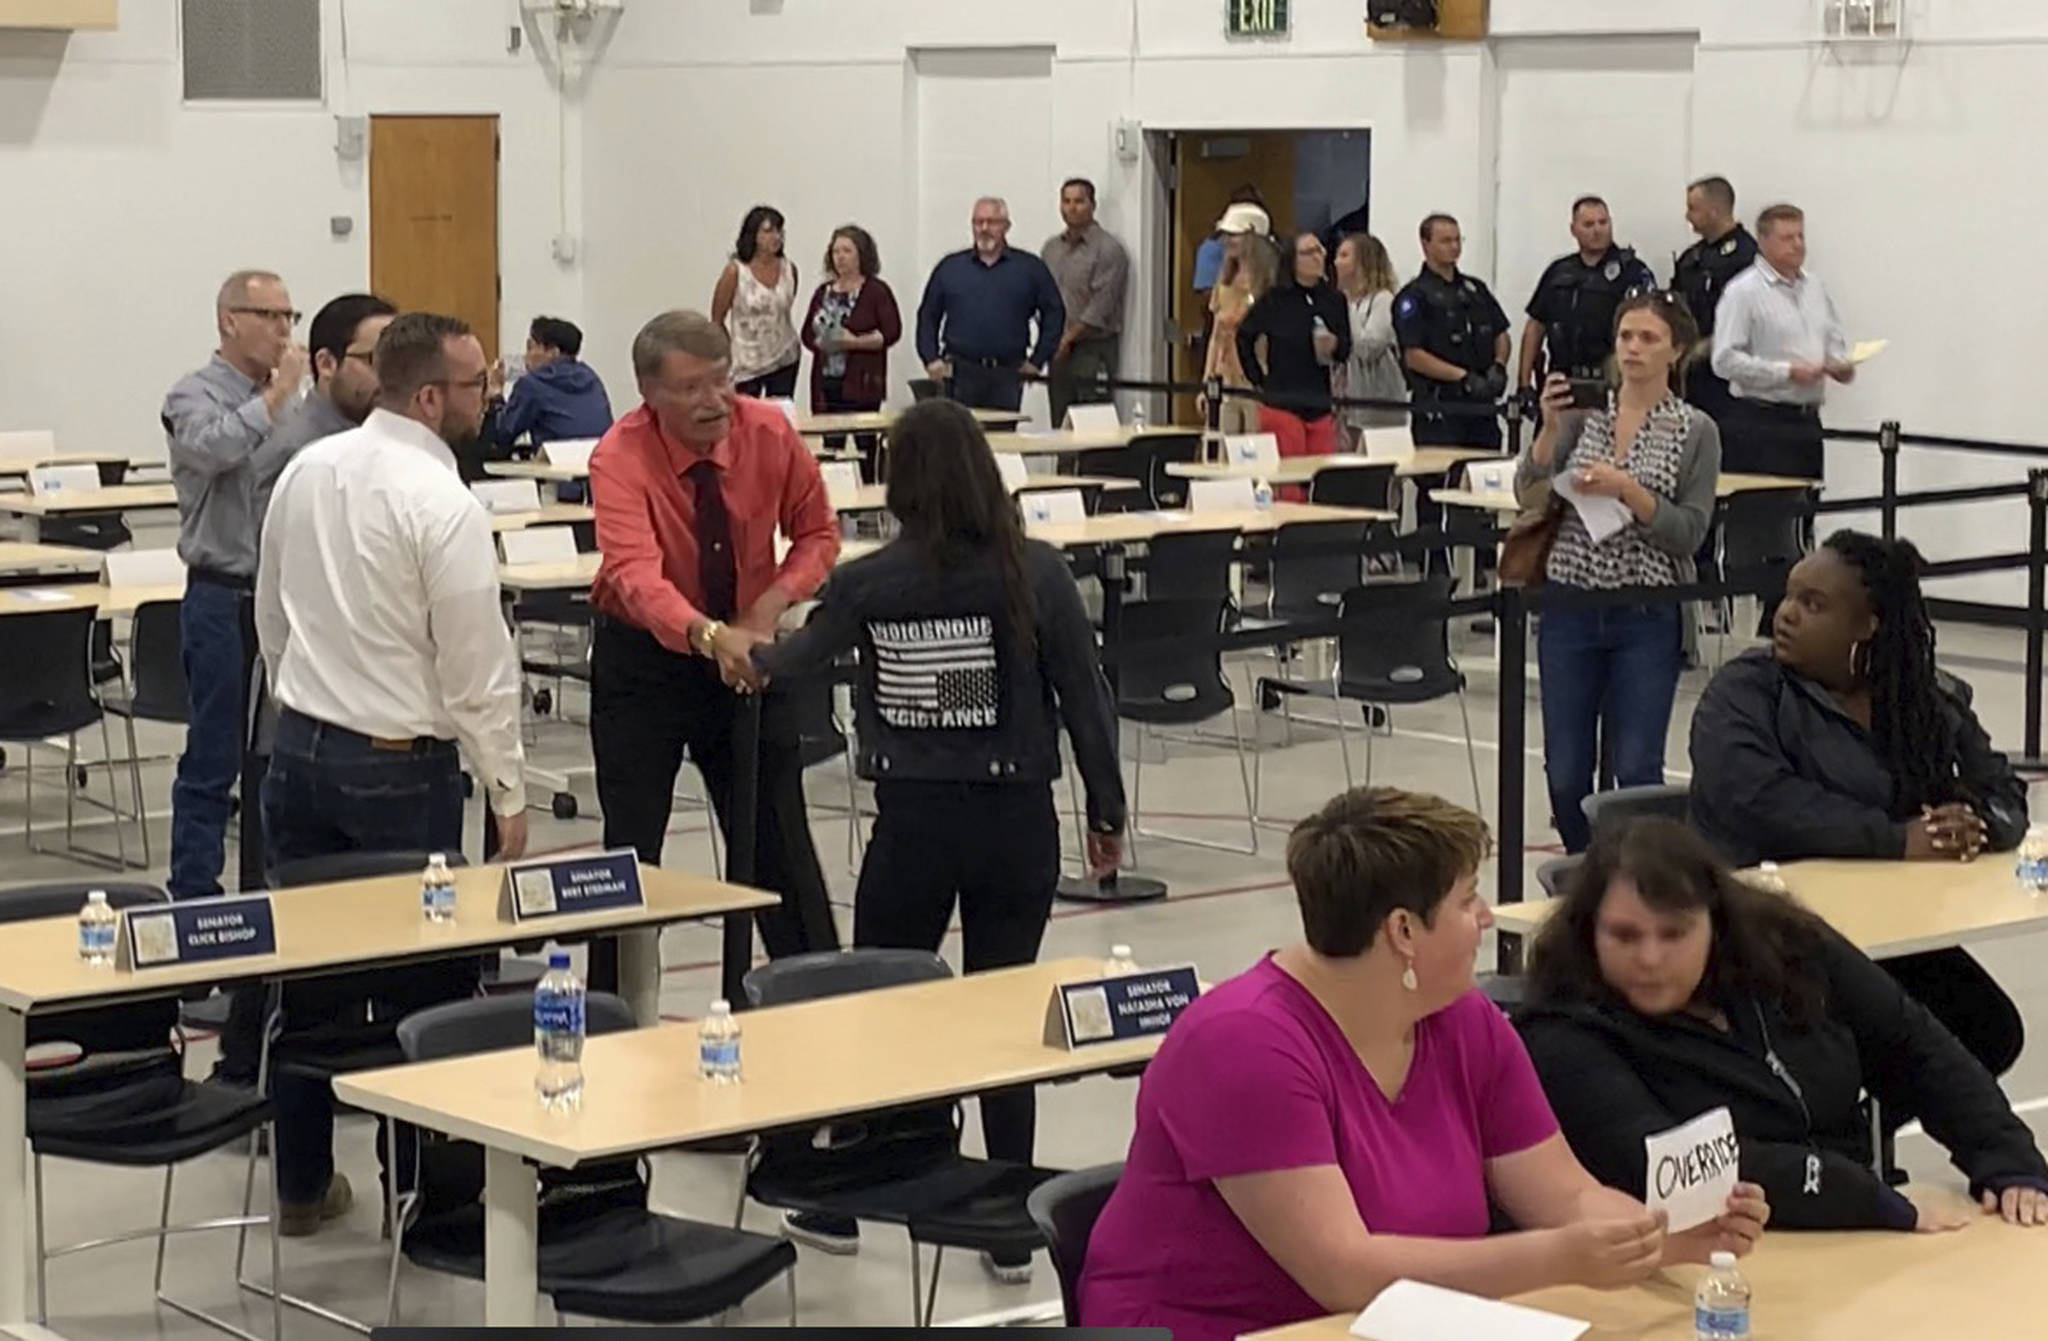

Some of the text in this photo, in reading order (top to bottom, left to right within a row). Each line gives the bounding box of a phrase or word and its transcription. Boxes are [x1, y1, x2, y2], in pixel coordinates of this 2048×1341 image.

[1240, 0, 1275, 31] EXIT
[569, 868, 613, 883] SENATOR
[197, 914, 244, 930] SENATOR
[218, 928, 257, 944] BISHOP
[1127, 979, 1172, 998] SENATOR
[1656, 1132, 1739, 1199] OVERRIDE
